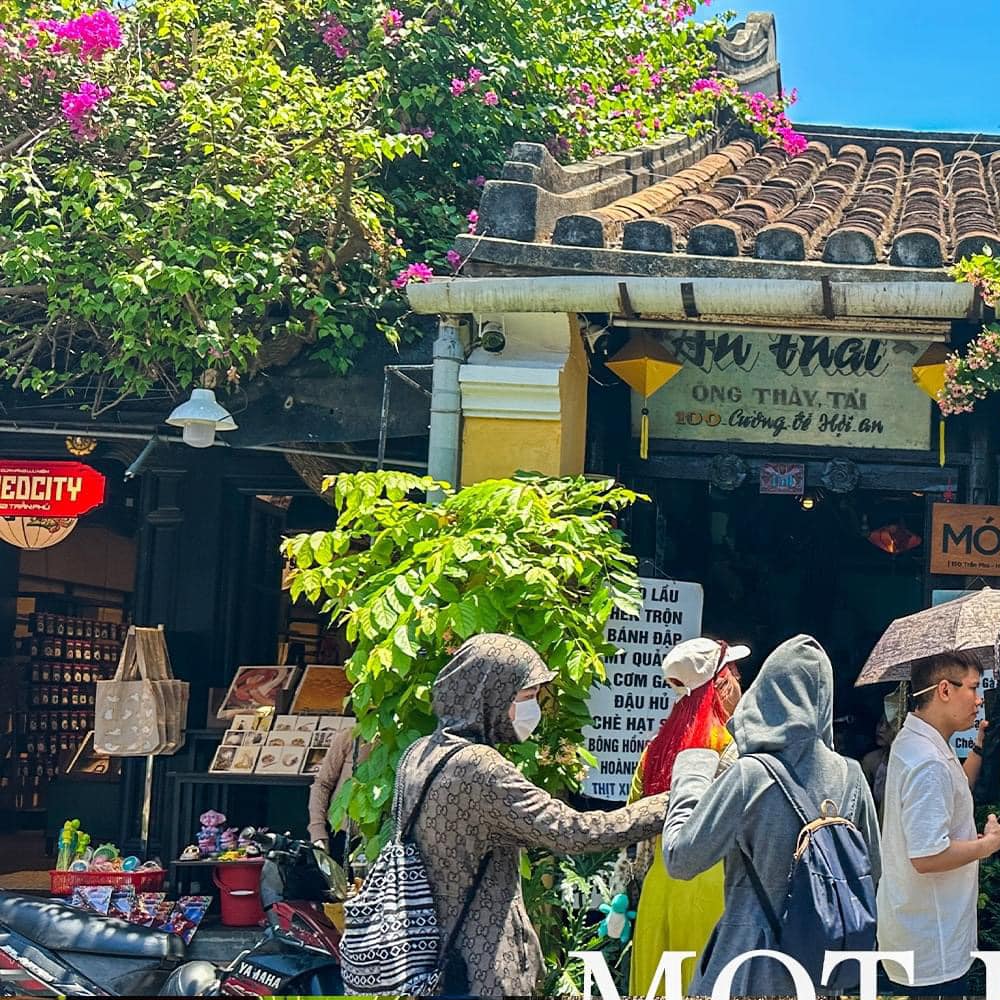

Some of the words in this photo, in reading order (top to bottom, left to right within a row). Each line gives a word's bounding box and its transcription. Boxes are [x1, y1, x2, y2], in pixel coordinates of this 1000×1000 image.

[0, 475, 83, 501] EDCITY
[645, 607, 683, 627] TRỘN
[607, 626, 649, 644] BÁNH
[653, 629, 682, 649] ĐẬP
[613, 672, 648, 688] CƠM
[614, 692, 645, 712] ĐẬU
[626, 717, 655, 734] HẠT
[592, 782, 615, 798] THỊT
